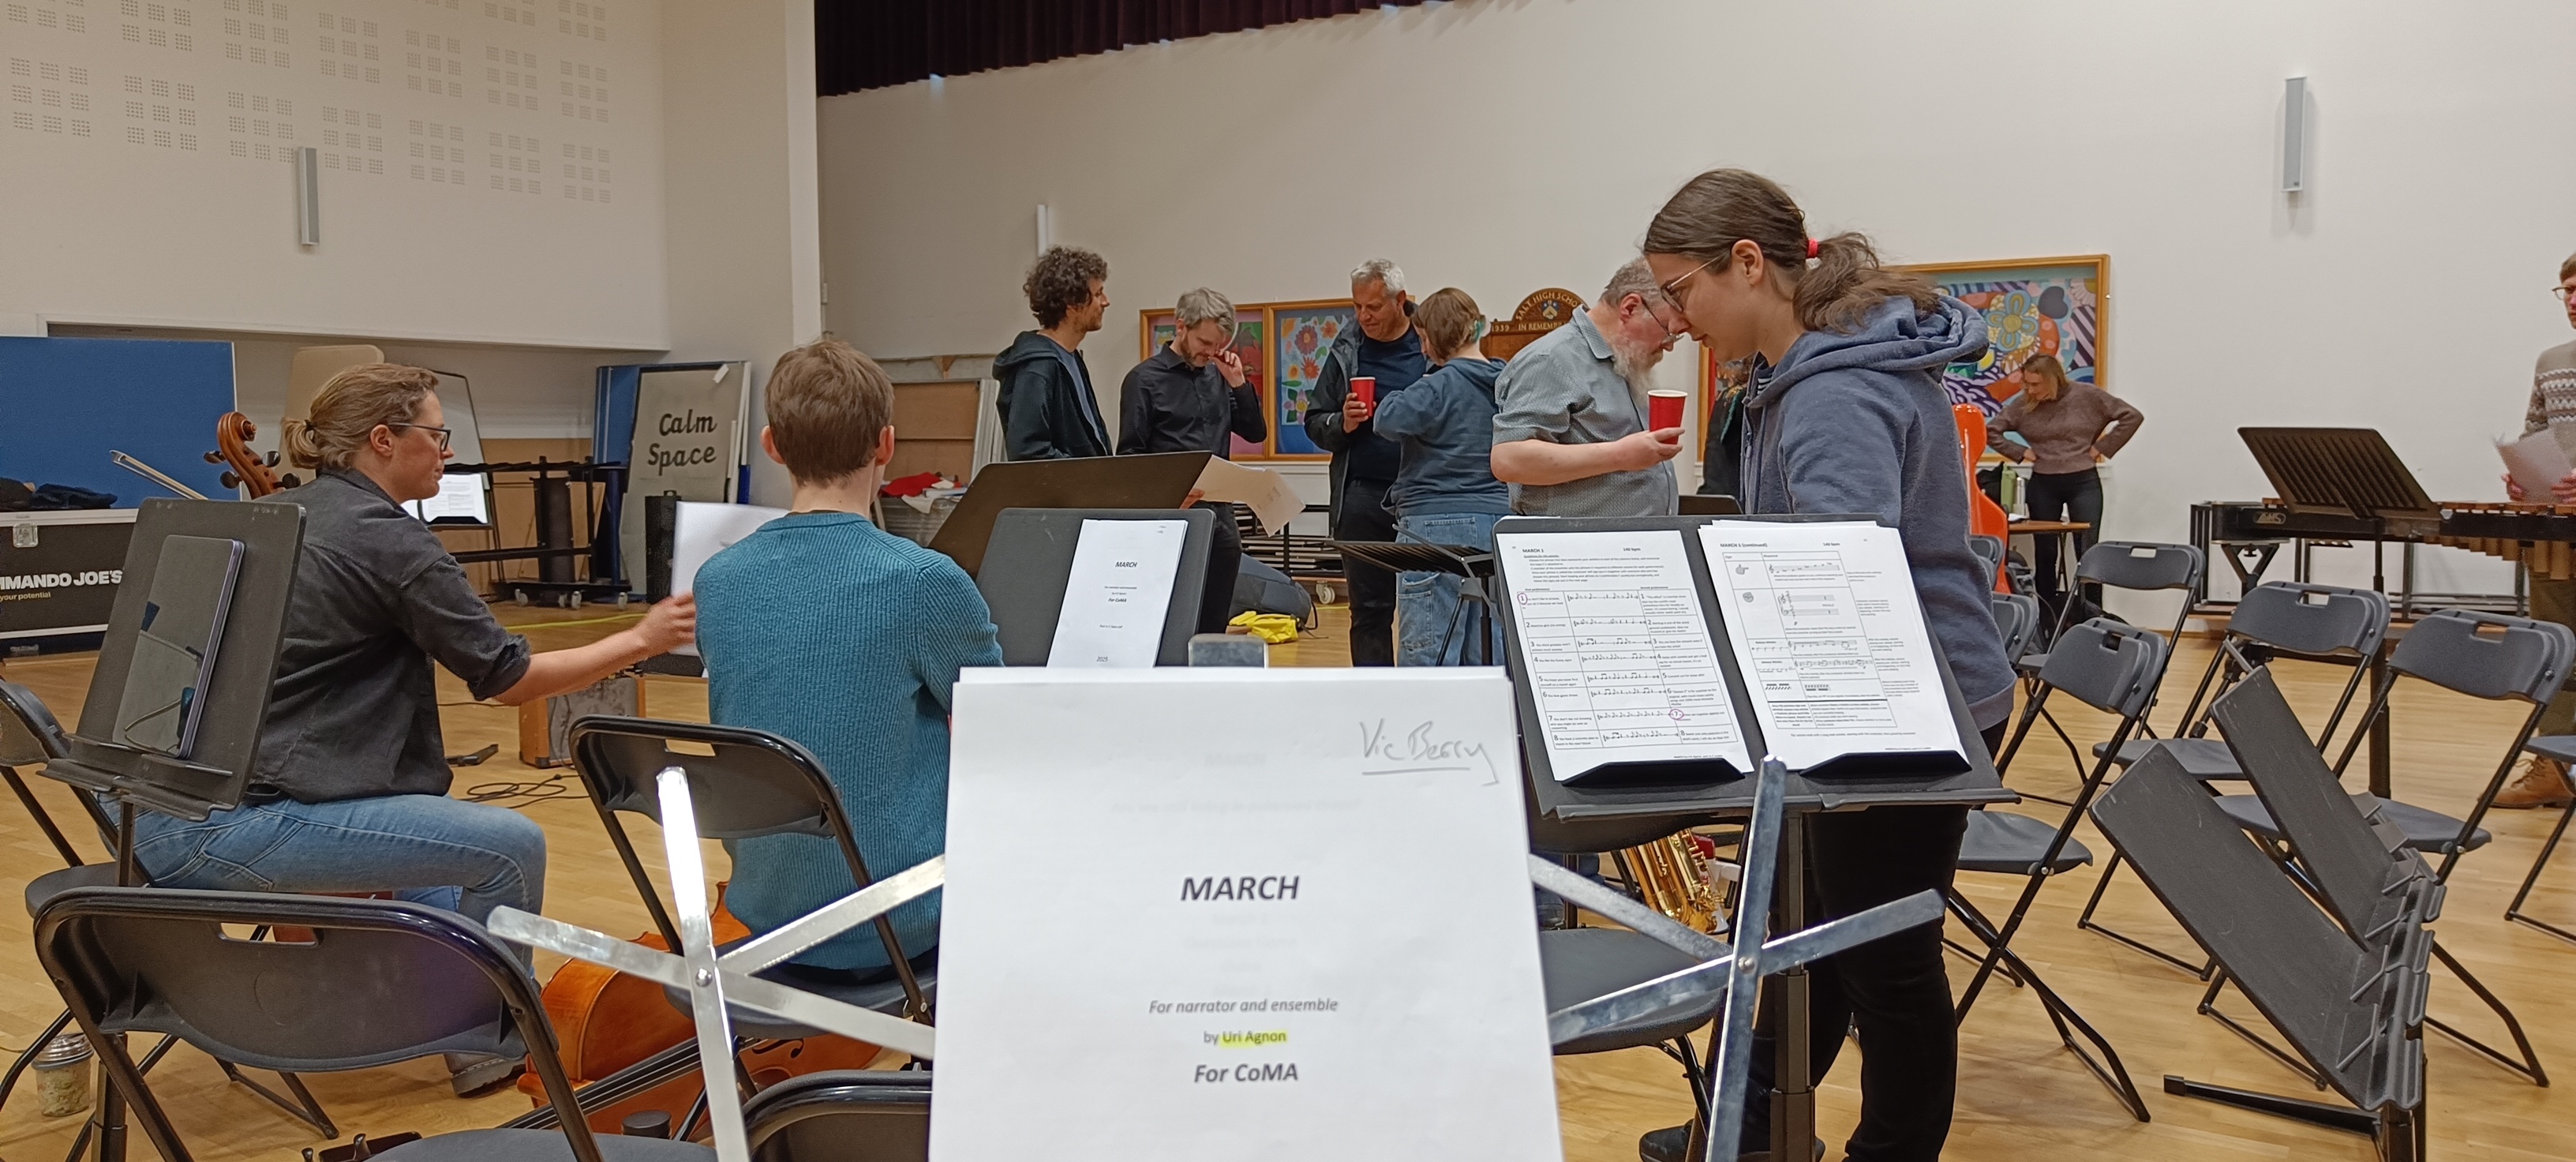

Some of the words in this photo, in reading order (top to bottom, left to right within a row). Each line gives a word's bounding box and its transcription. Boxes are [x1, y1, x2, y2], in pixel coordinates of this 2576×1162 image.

[1515, 299, 1533, 320] SALT
[1533, 291, 1556, 304] HIGH
[1556, 292, 1578, 308] SCHO
[659, 409, 717, 437] Calm
[647, 443, 717, 476] Space
[73, 569, 123, 587] JOE'S
[18, 591, 51, 601] potential
[1359, 718, 1406, 760] Vic
[1181, 875, 1300, 901] MARCH
[1149, 999, 1174, 1014] For
[1176, 999, 1236, 1014] narrator
[1239, 999, 1267, 1013] and
[1270, 997, 1339, 1013] ensemble
[1203, 1031, 1219, 1046] by
[1222, 1030, 1241, 1044] Uri
[1245, 1030, 1286, 1047] Agnon
[1194, 1064, 1230, 1083] For
[1234, 1063, 1298, 1082] CoMA
